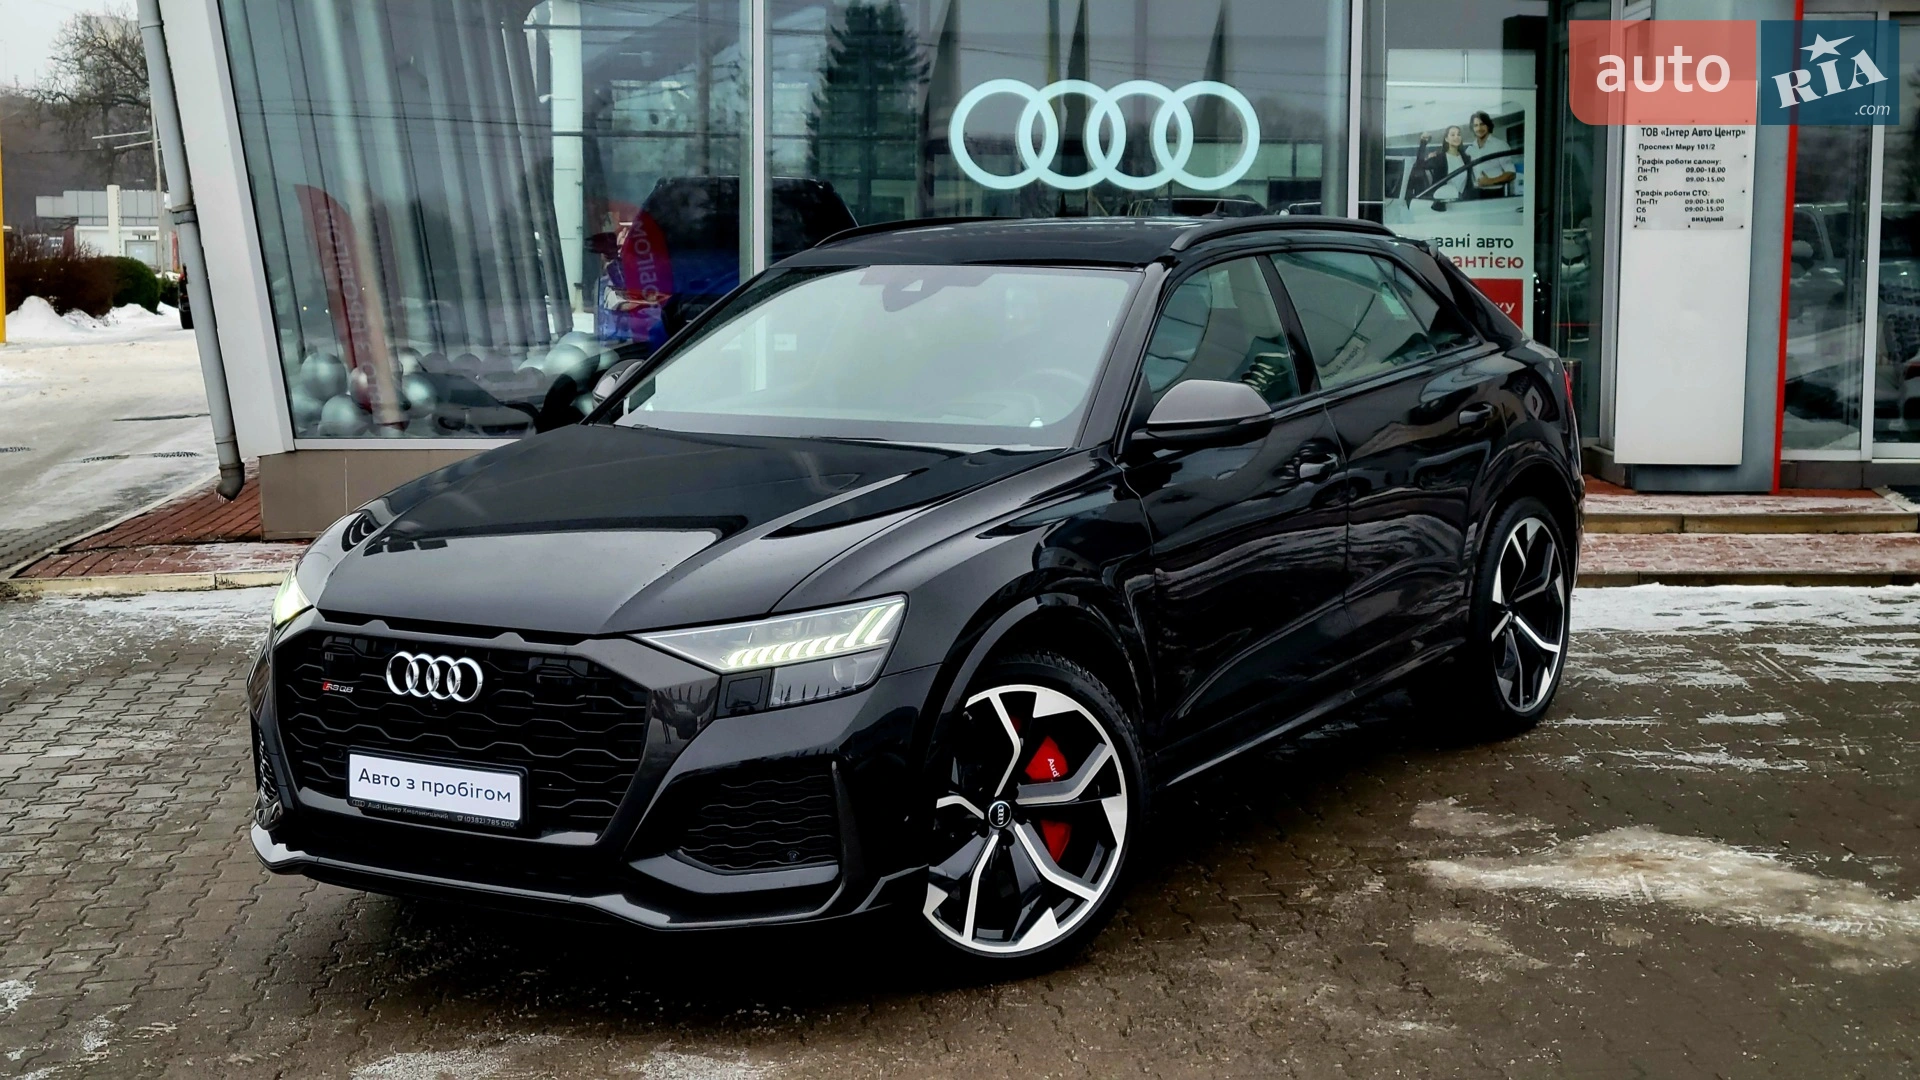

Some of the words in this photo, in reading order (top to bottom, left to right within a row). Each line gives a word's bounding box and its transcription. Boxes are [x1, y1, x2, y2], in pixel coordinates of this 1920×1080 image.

[1641, 127, 1658, 137] ТОВ
[1661, 127, 1690, 139] «Інтер
[1691, 127, 1713, 137] Авто
[1714, 127, 1746, 139] Центр»
[1638, 143, 1674, 151] Проспект
[1675, 143, 1695, 151] Миру
[1637, 158, 1664, 166] Графік
[1665, 158, 1691, 166] роботи
[1693, 158, 1722, 166] салону:
[1637, 166, 1660, 174] Пн-Пт
[1664, 189, 1690, 197] роботи
[1691, 189, 1710, 197] СТО:
[1635, 215, 1646, 223] Нд
[1691, 215, 1724, 223] вихідний
[1435, 233, 1470, 248] вані
[1476, 237, 1514, 249] авто
[1452, 251, 1524, 269] антією
[358, 768, 400, 788] Авто
[406, 778, 415, 790] з
[421, 780, 511, 803] пробігом
